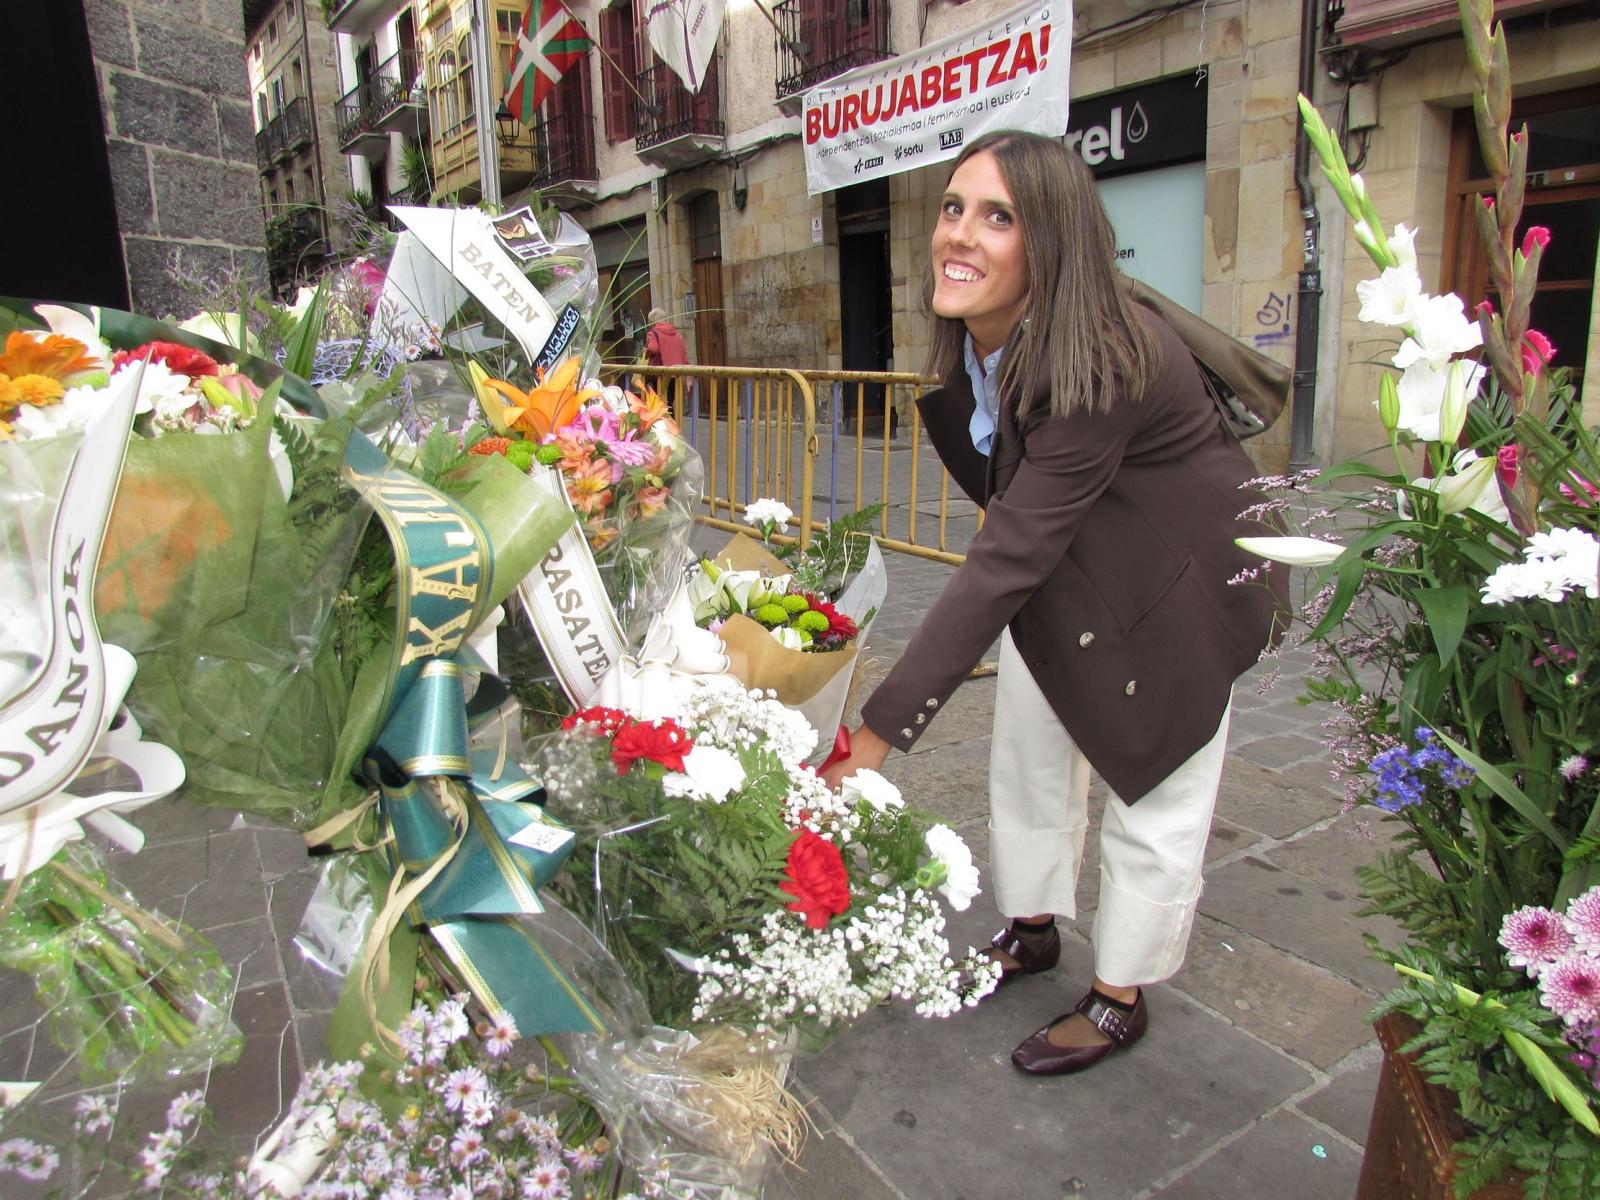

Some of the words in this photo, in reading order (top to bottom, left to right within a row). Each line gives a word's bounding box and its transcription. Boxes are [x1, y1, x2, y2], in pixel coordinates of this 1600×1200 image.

[806, 24, 1051, 145] BURUJABETZA!
[903, 143, 924, 157] sortu
[940, 130, 963, 147] LAB
[1064, 107, 1125, 166] rel
[458, 241, 540, 325] BATEN
[540, 541, 611, 688] RASATE
